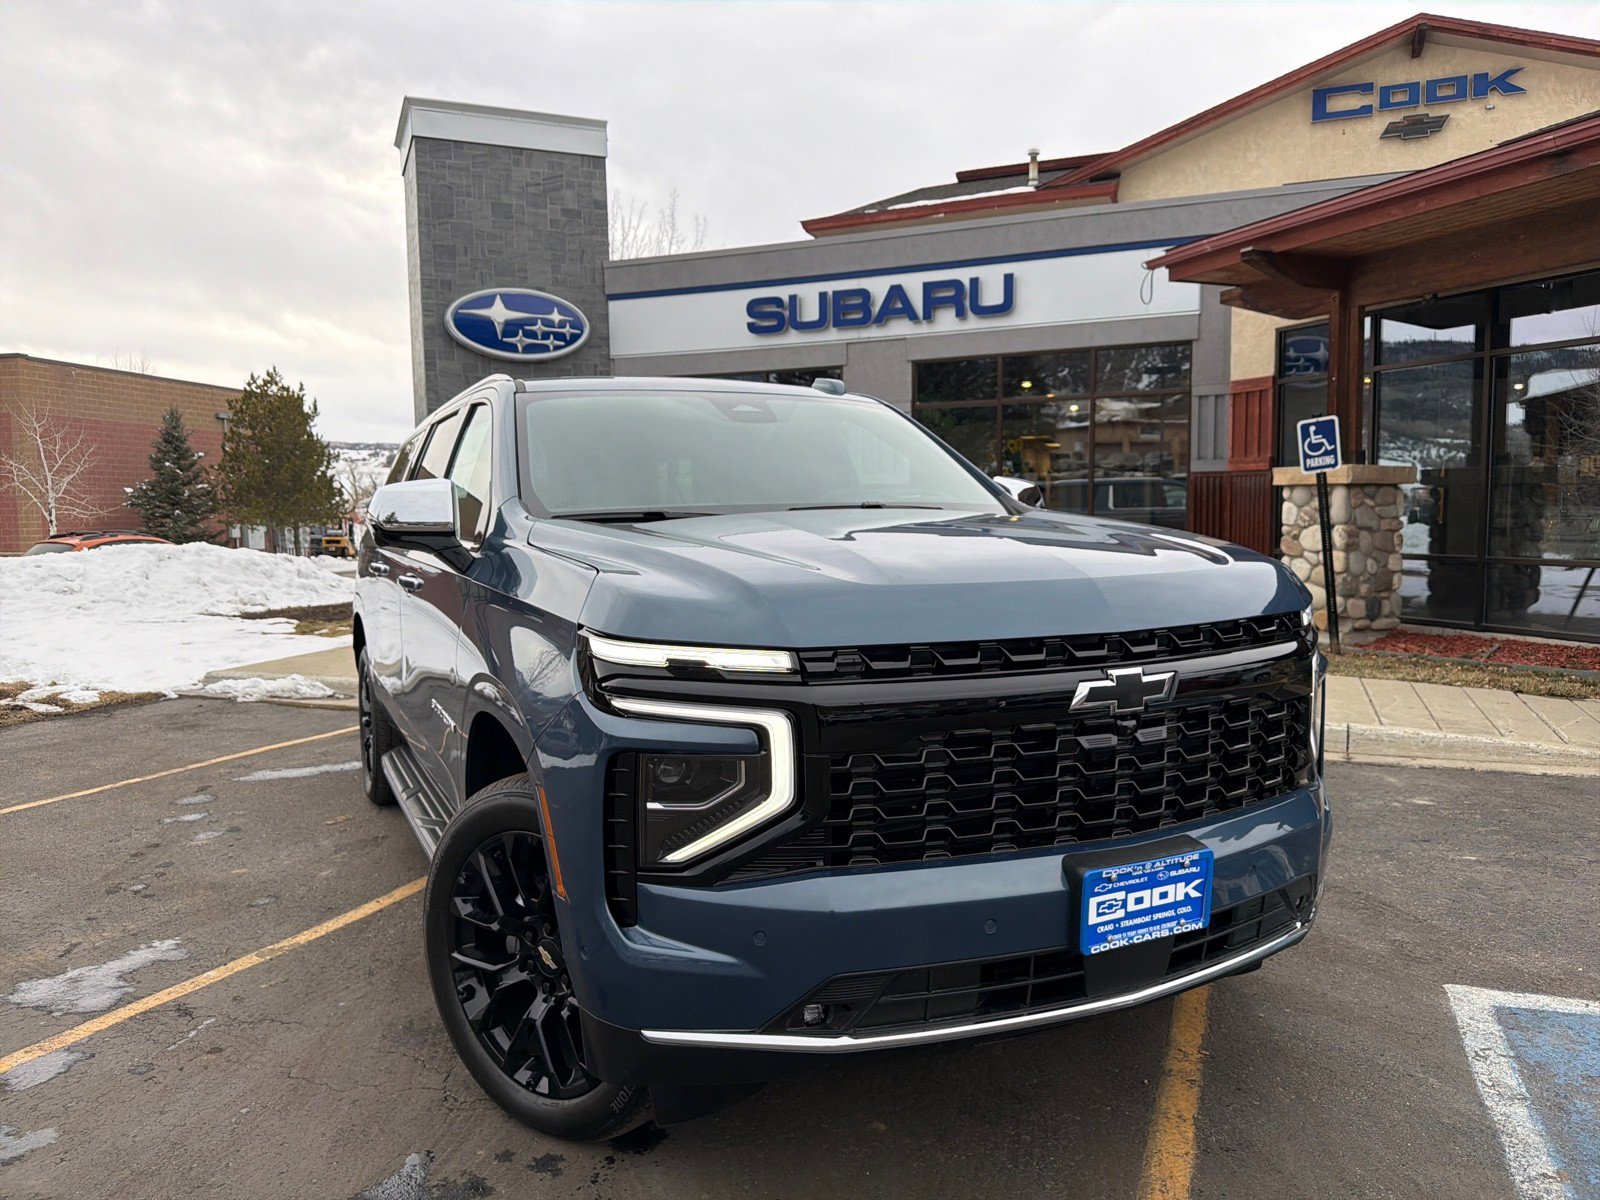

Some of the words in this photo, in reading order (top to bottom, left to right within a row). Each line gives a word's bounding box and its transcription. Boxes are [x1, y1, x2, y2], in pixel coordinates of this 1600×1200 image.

[1311, 67, 1528, 124] COOK
[746, 272, 1015, 335] SUBARU
[1305, 455, 1335, 468] PARKING
[1153, 854, 1200, 868] ALTITUDE
[1169, 866, 1200, 877] SUBARU
[1113, 876, 1148, 888] CHEVROLET
[1088, 878, 1204, 926] COOK
[1096, 923, 1114, 934] CRAIG
[1120, 914, 1152, 928] STEAMBOAT
